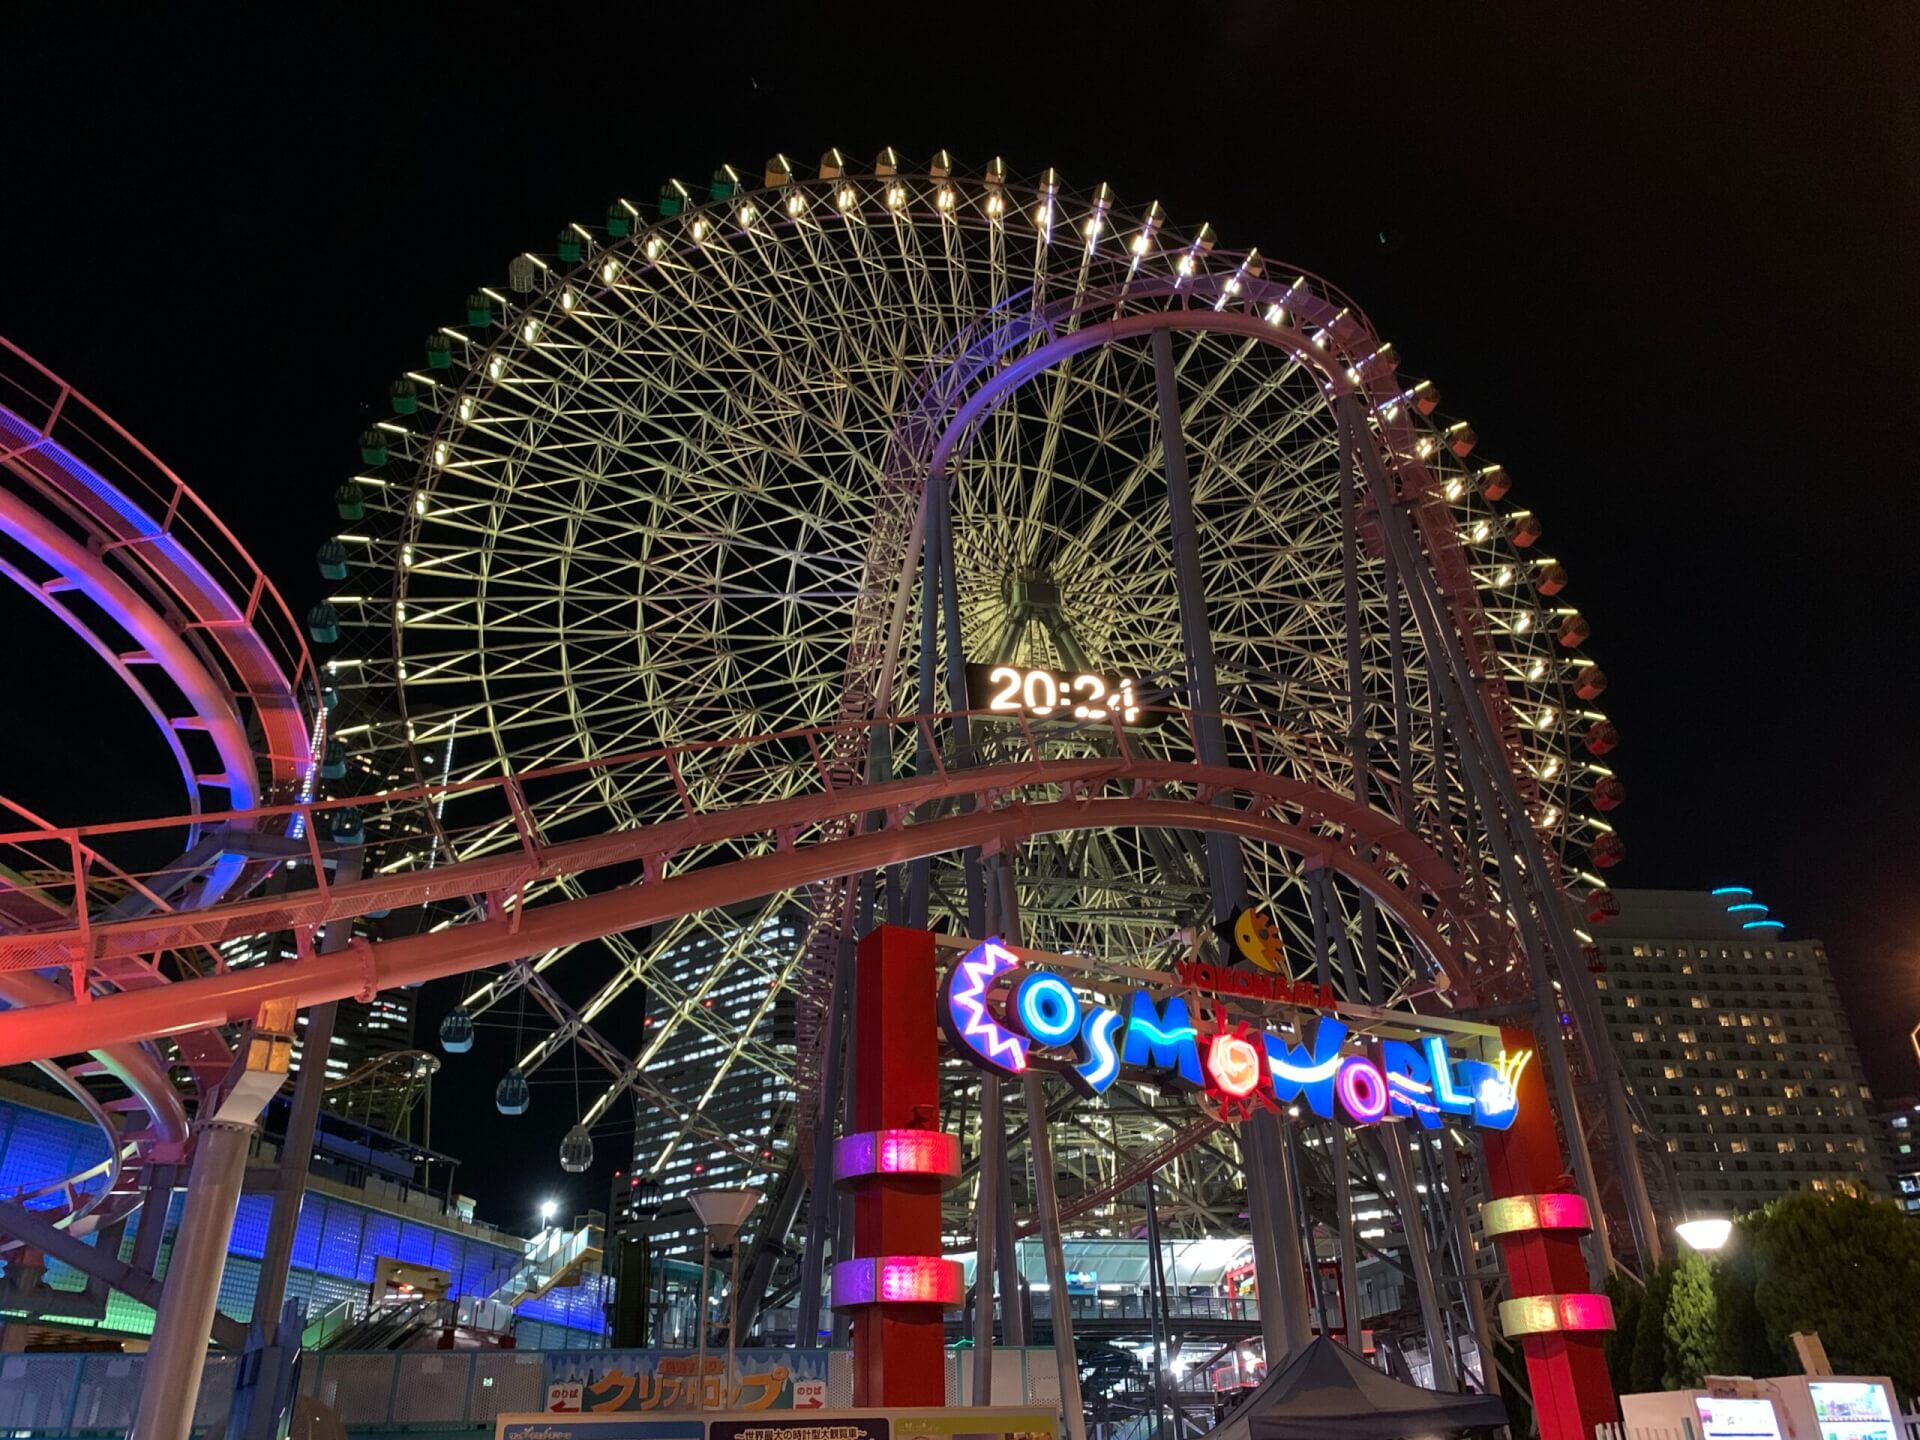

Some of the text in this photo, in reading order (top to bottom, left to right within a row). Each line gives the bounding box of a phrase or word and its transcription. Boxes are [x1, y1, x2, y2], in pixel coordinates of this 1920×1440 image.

[990, 667, 1140, 722] 20:24
[1176, 960, 1337, 1009] YOKOHAMA
[552, 1389, 578, 1399] のりば
[797, 1386, 822, 1396] のりば
